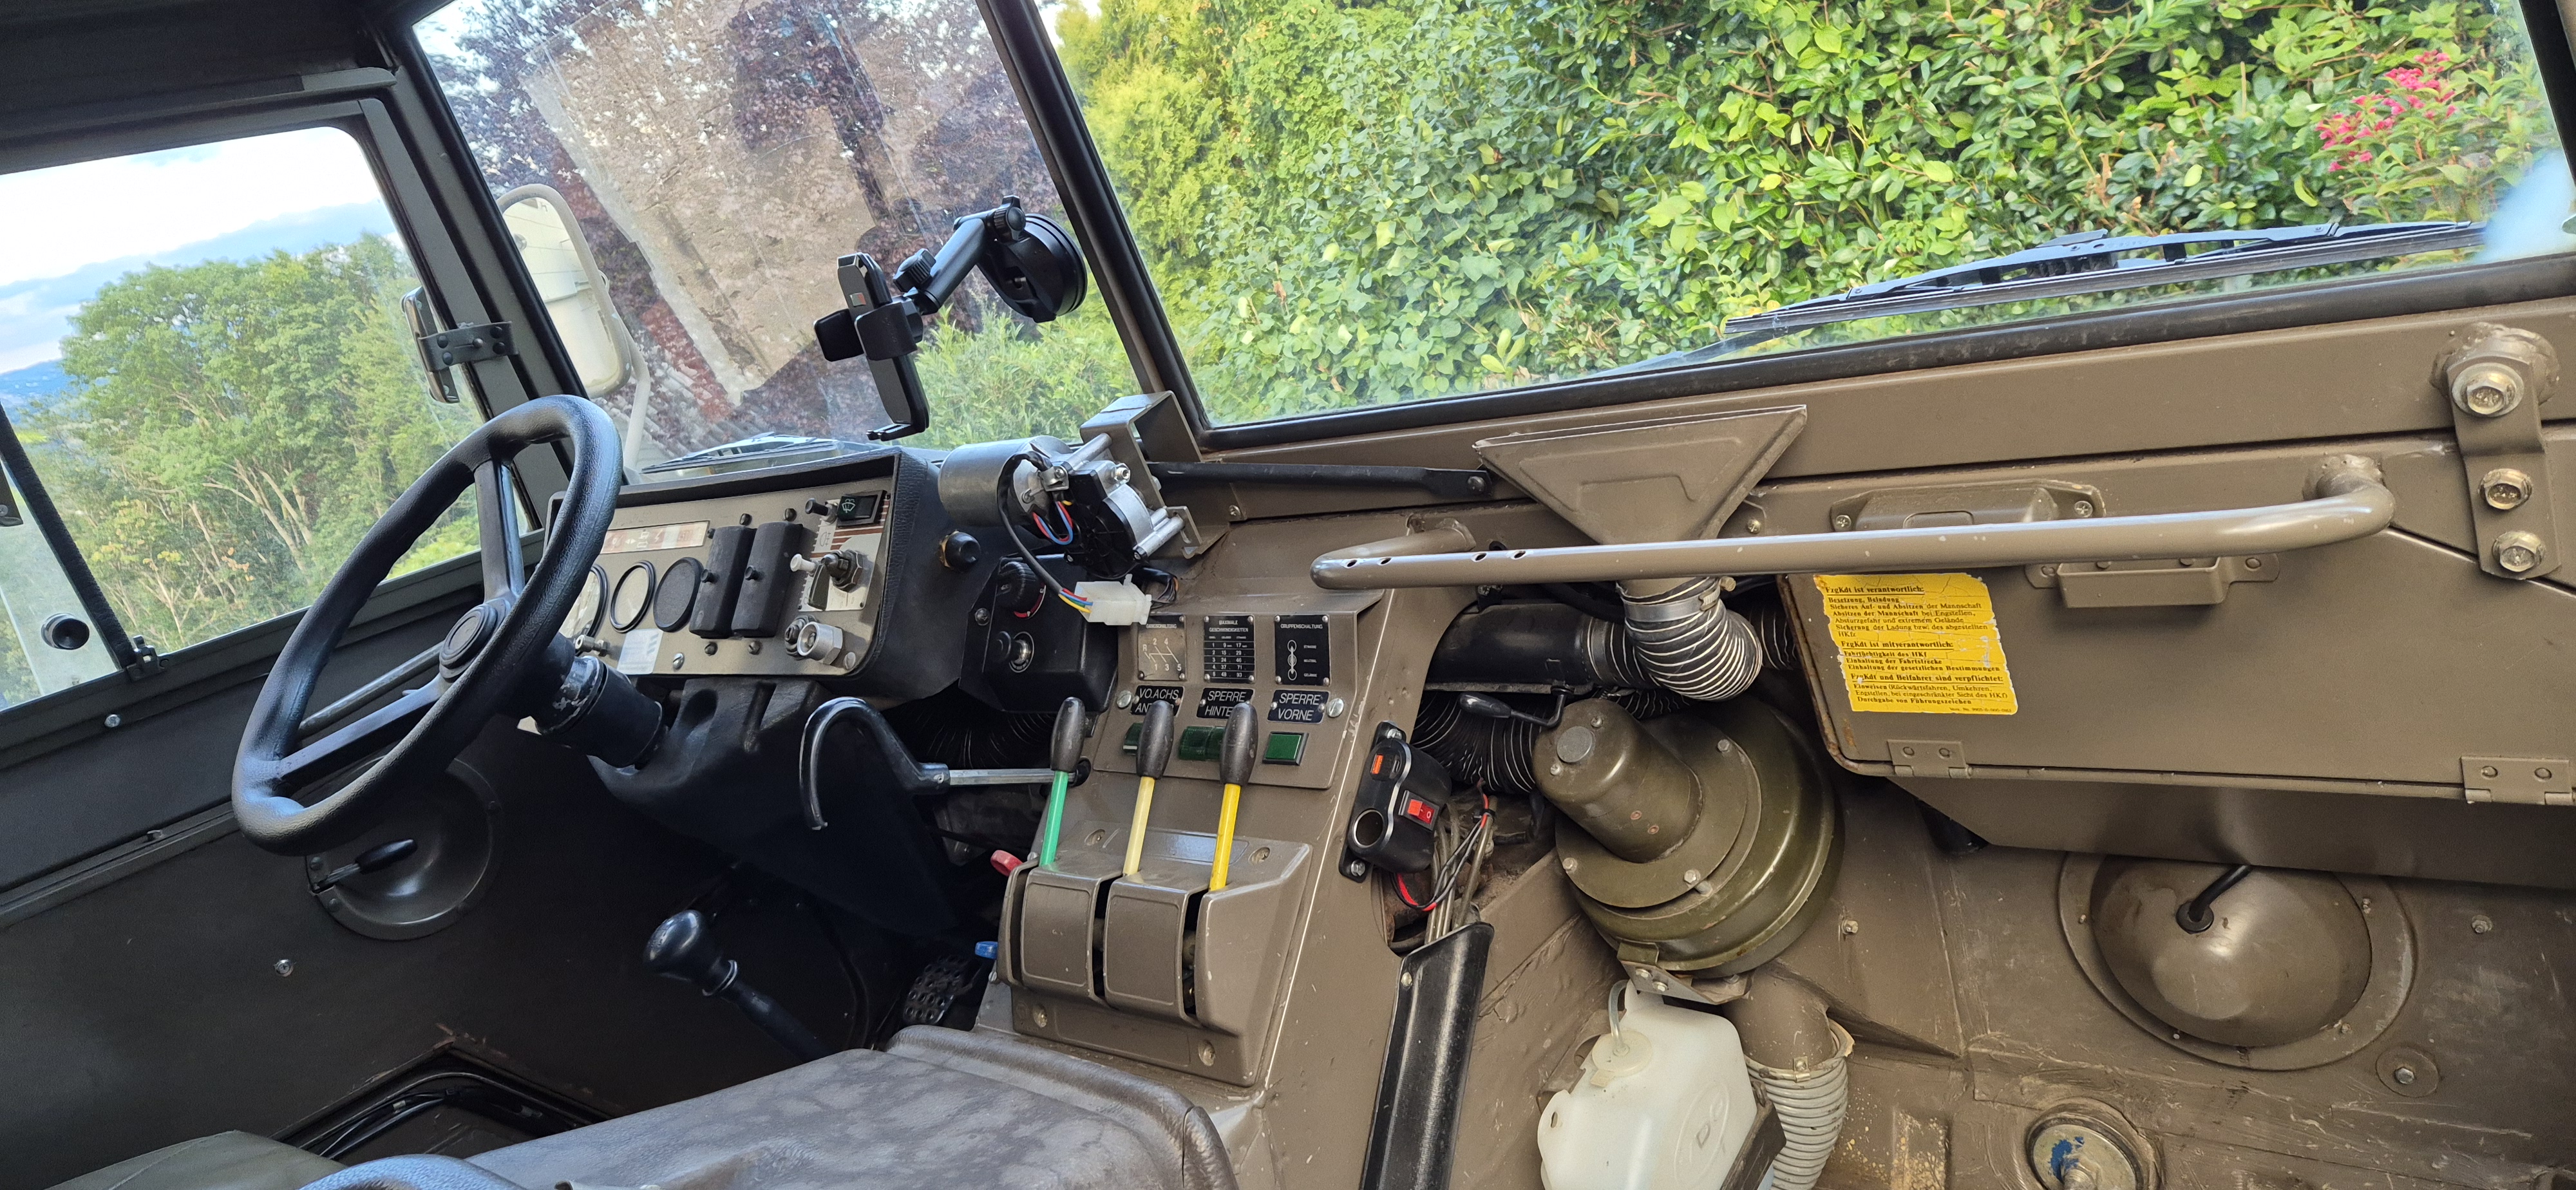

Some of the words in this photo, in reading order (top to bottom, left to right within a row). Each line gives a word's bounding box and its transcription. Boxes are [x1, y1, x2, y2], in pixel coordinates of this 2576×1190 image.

[1207, 690, 1247, 702] SPERRE
[1279, 692, 1321, 706] SPERRE
[1278, 708, 1314, 721] VORNE
